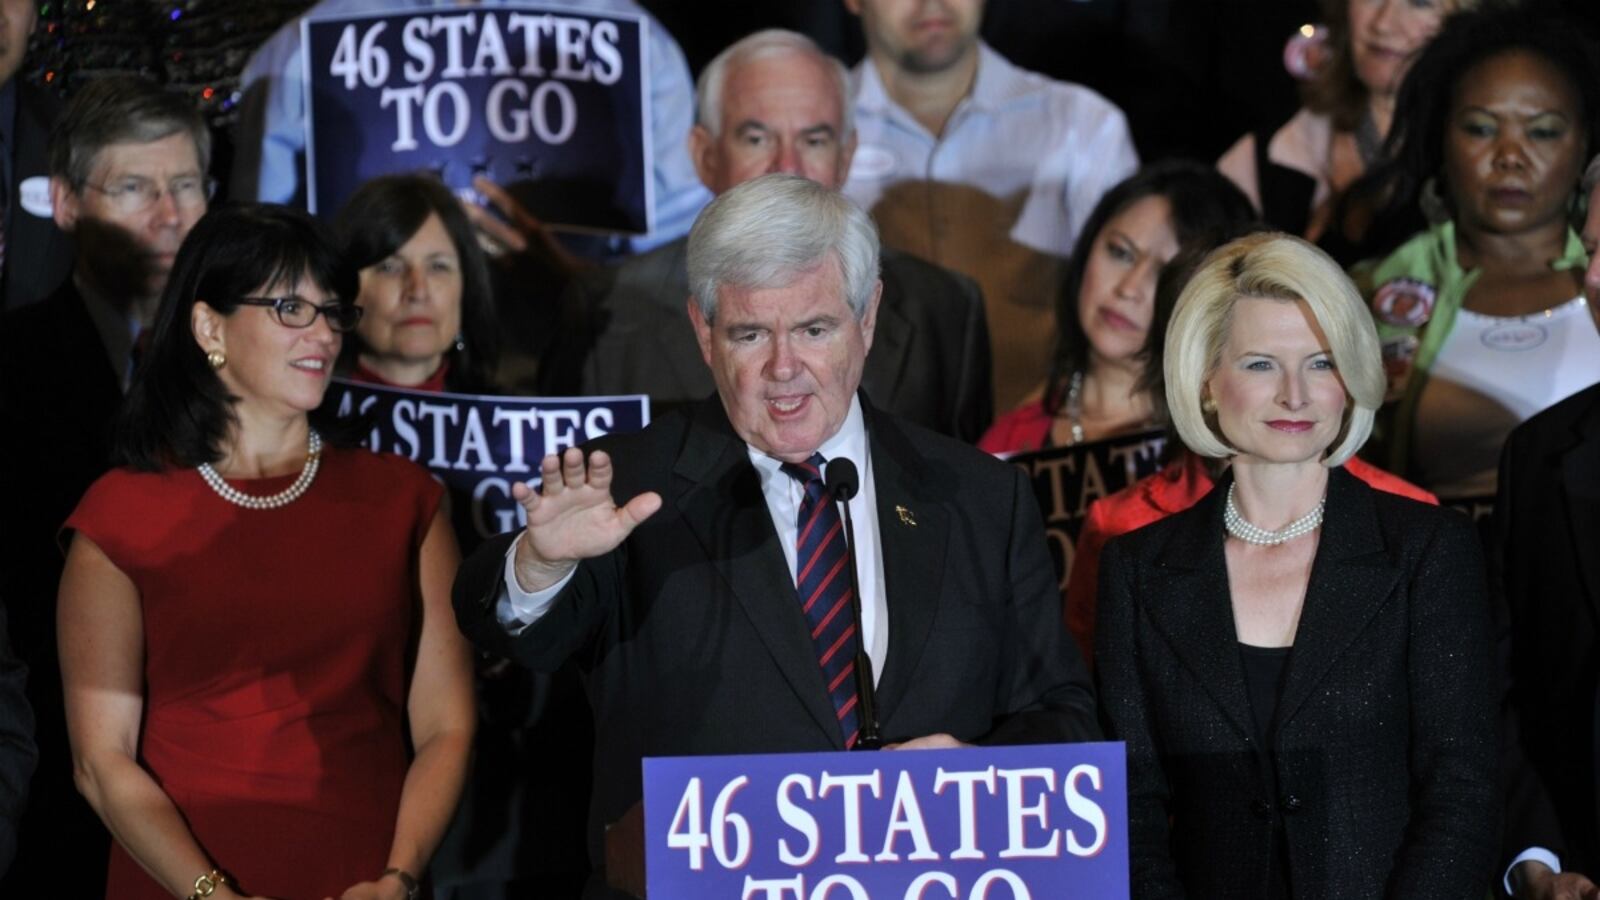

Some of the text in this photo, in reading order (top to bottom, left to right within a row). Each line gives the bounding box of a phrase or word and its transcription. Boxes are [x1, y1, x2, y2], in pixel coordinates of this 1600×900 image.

[330, 12, 623, 90] 46 STATES
[380, 78, 577, 152] TO GO
[1015, 437, 1168, 523] TAT
[667, 763, 1107, 870] 46 STATES
